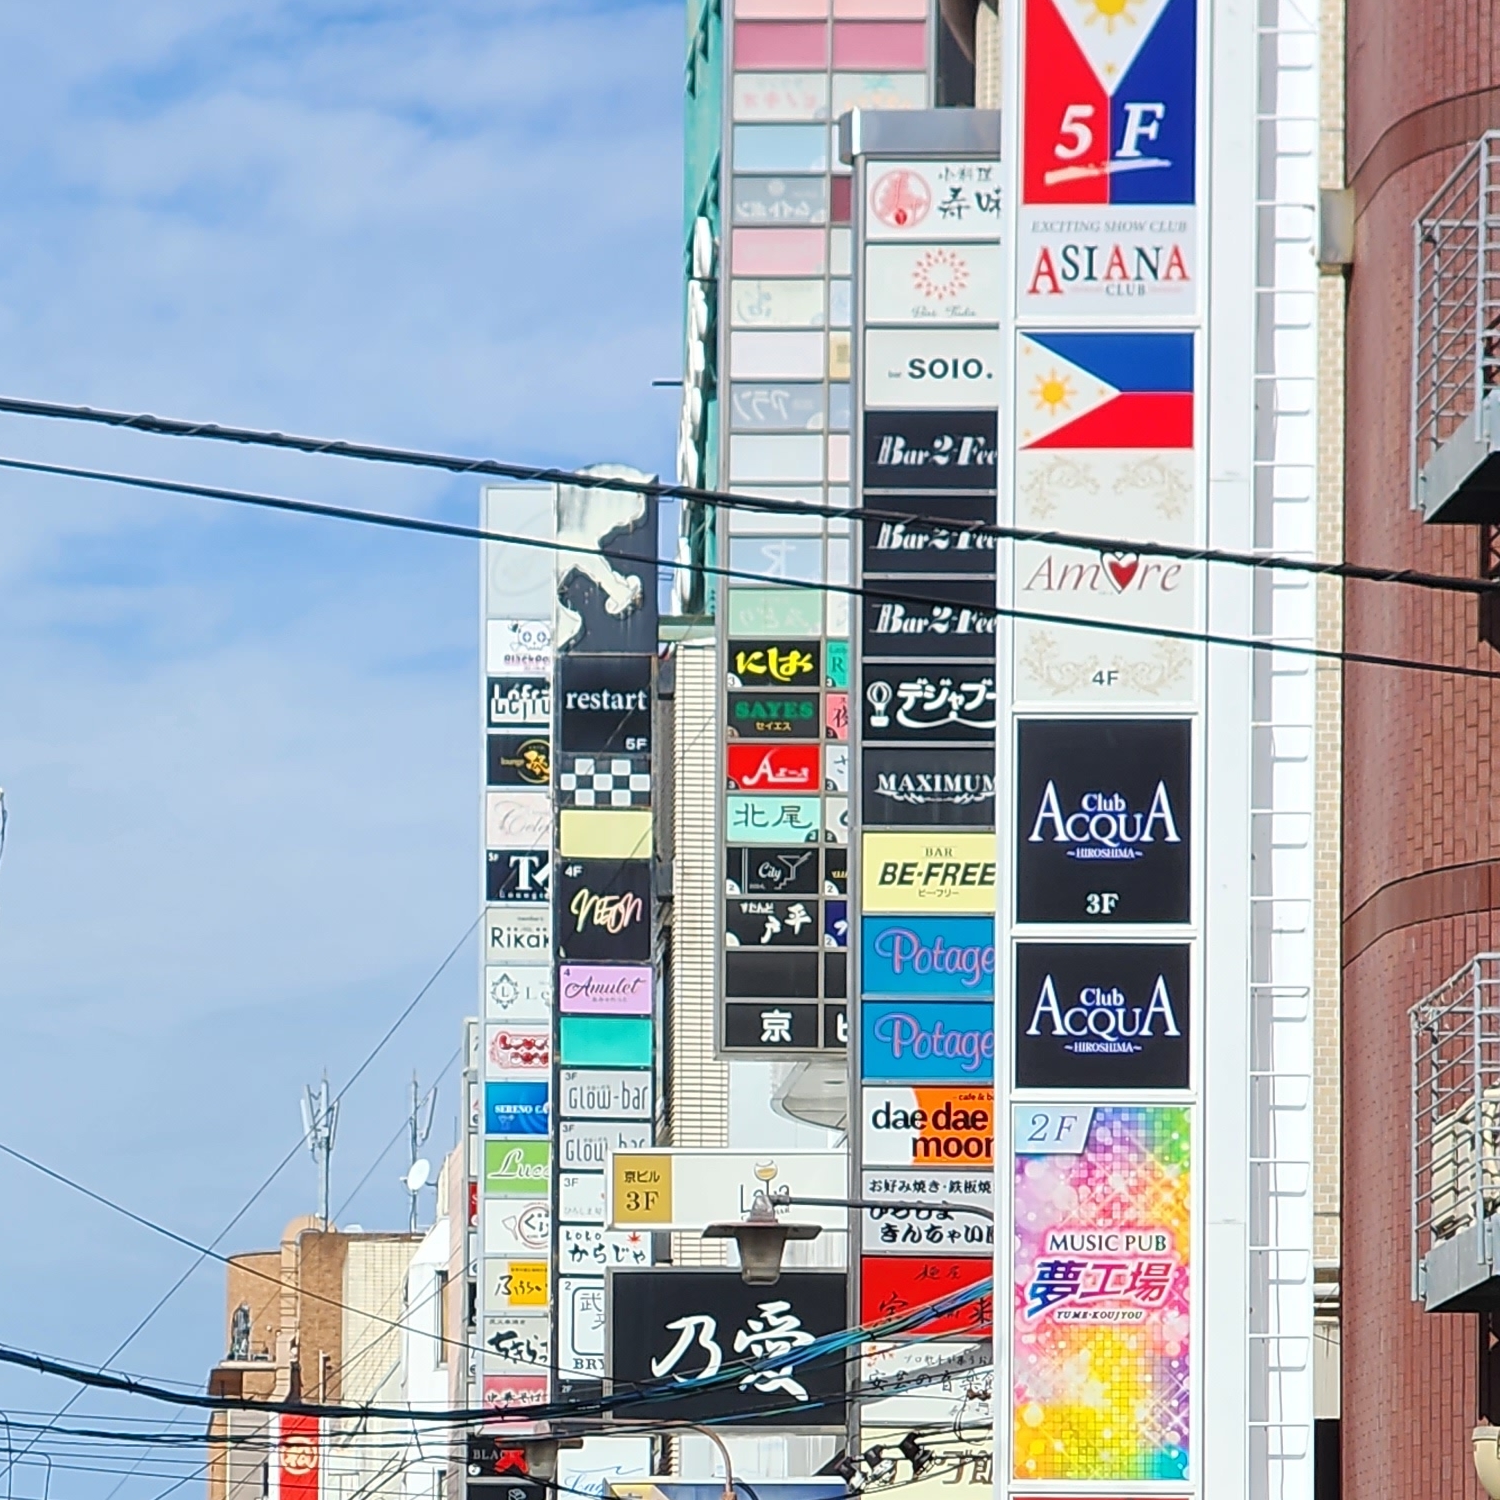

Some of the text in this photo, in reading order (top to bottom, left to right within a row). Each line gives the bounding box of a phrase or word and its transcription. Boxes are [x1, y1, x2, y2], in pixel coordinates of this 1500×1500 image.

[1030, 220, 1187, 233] EXCITING SHOW CLUB
[1028, 244, 1189, 295] ASIANA
[1105, 284, 1146, 297] CLUB
[1092, 671, 1119, 685] 4F
[565, 691, 648, 712] restart
[626, 738, 648, 751] 5F
[1028, 779, 1182, 847] ACQUA
[1082, 793, 1126, 812] Club
[733, 803, 813, 829] 北尾
[925, 847, 953, 857] BAR
[565, 866, 582, 877] 4F
[1086, 893, 1119, 915] 3F
[874, 926, 996, 988] Potage
[565, 975, 645, 998] Amulet
[1079, 987, 1125, 1007] Club
[1025, 974, 1181, 1042] ACQUA
[761, 1010, 793, 1043] 京
[874, 1012, 996, 1072] Potage
[565, 1072, 577, 1081] 3F
[871, 1102, 989, 1130] dae dae
[562, 1123, 574, 1132] 3F
[1027, 1113, 1078, 1142] 2F
[564, 1178, 578, 1188] 3F
[623, 1170, 660, 1184] 京ビル
[626, 1190, 660, 1211] 3F
[1049, 1234, 1168, 1253] MUSIC PUB
[1026, 1259, 1172, 1319] 夢工場
